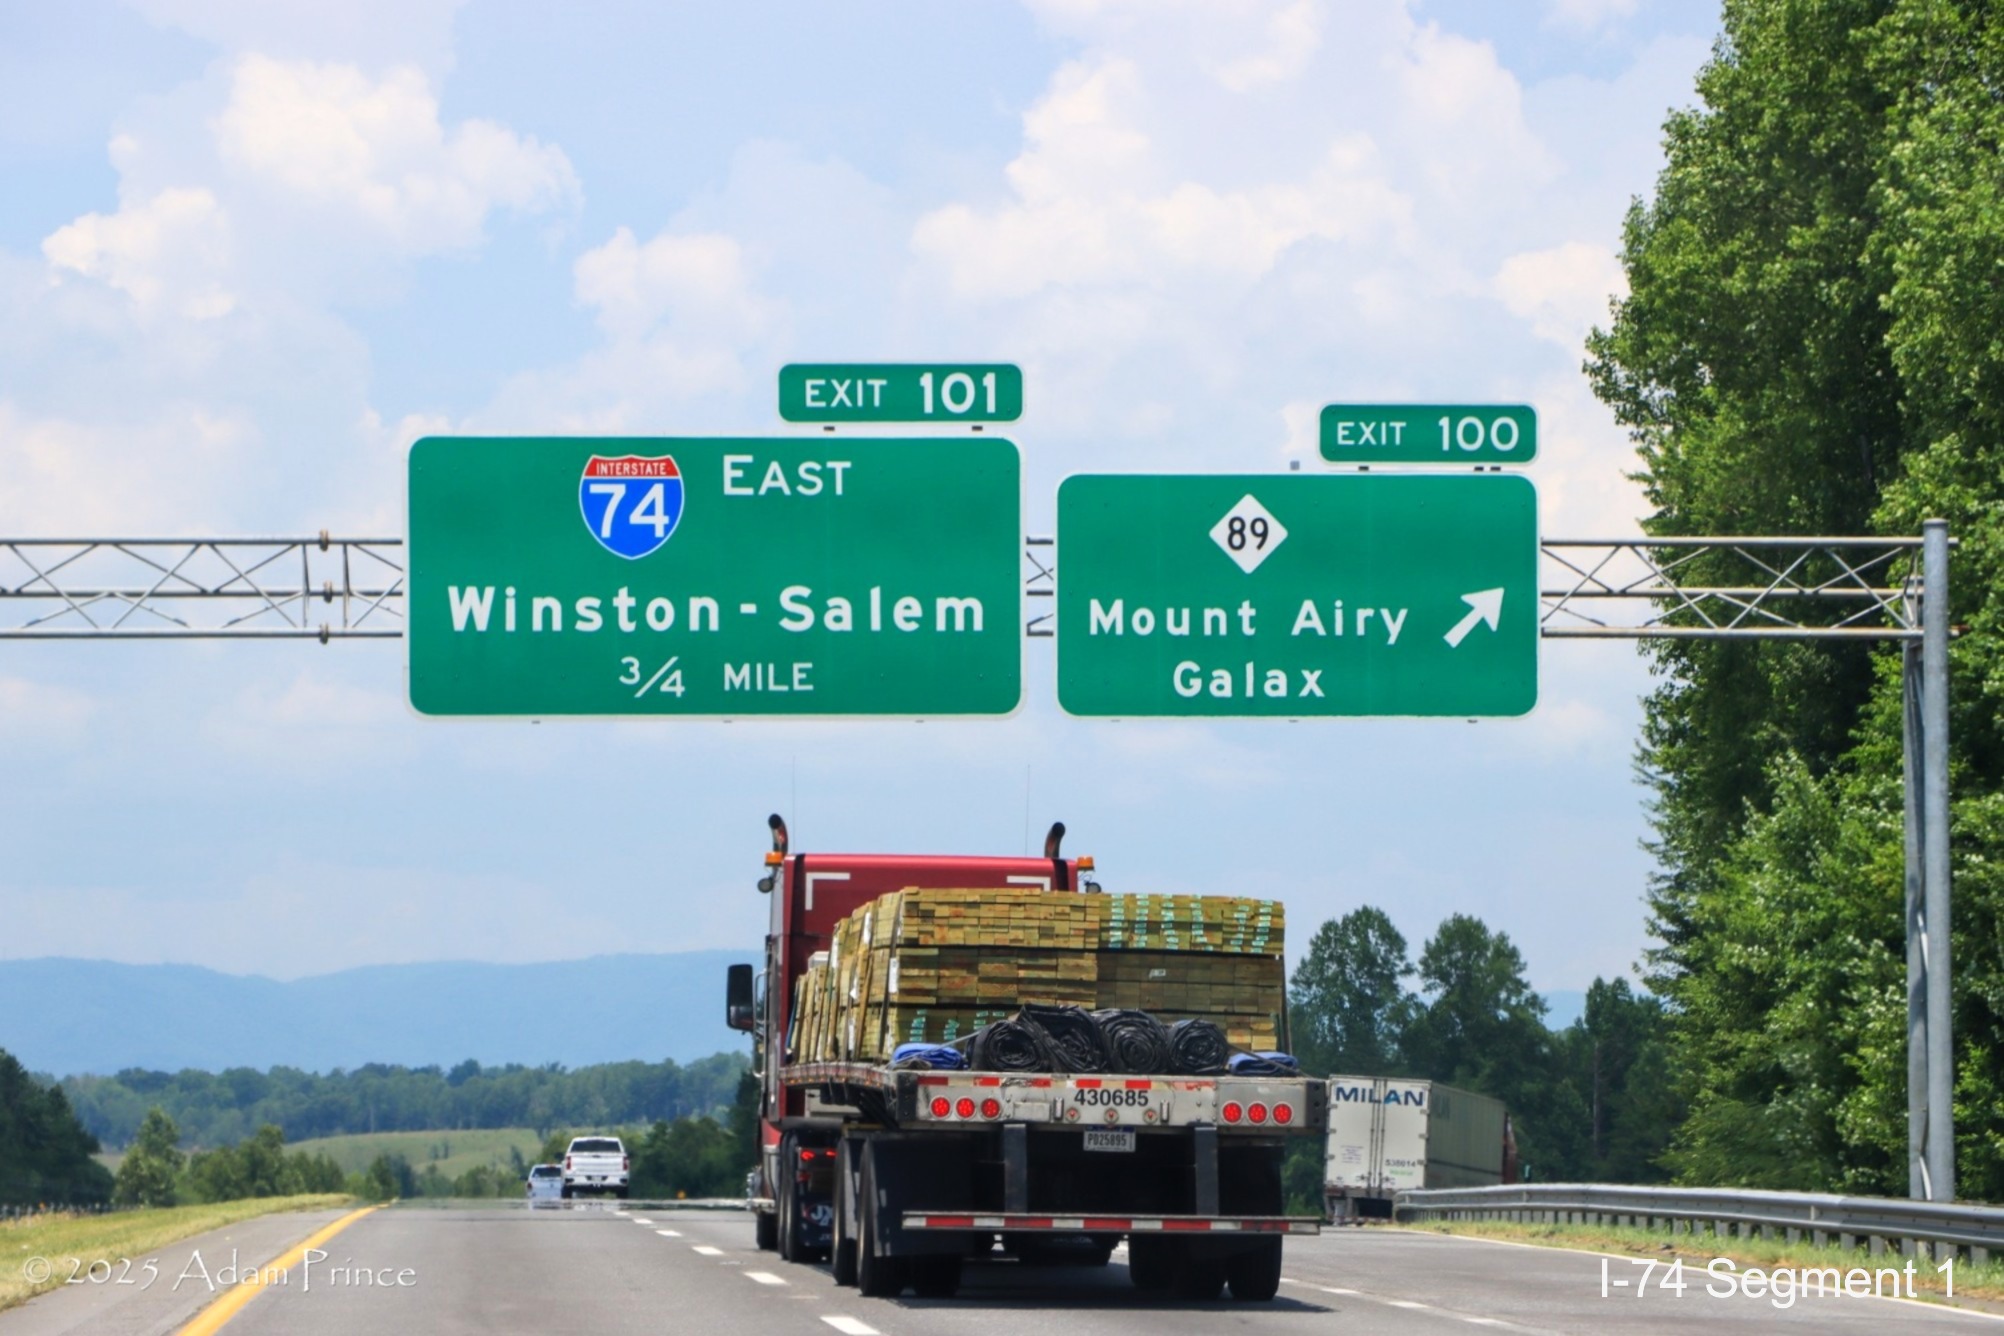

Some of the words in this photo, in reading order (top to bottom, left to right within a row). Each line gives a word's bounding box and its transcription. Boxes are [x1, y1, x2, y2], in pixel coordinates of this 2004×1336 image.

[804, 378, 888, 408] EXIT
[919, 372, 997, 414] 101
[1336, 421, 1407, 446] EXIT
[1438, 416, 1519, 452] 100
[596, 461, 667, 476] INTERSTATE
[723, 454, 852, 496] EAST
[589, 483, 670, 539] 74
[1227, 516, 1269, 551] 89
[1088, 598, 1257, 637] Mount
[1290, 599, 1409, 645] Airy
[619, 656, 686, 698] 3/4
[724, 662, 814, 692] MILE
[1173, 660, 1325, 698] Galax
[1074, 1089, 1149, 1107] 430685
[1335, 1086, 1424, 1107] MILAN
